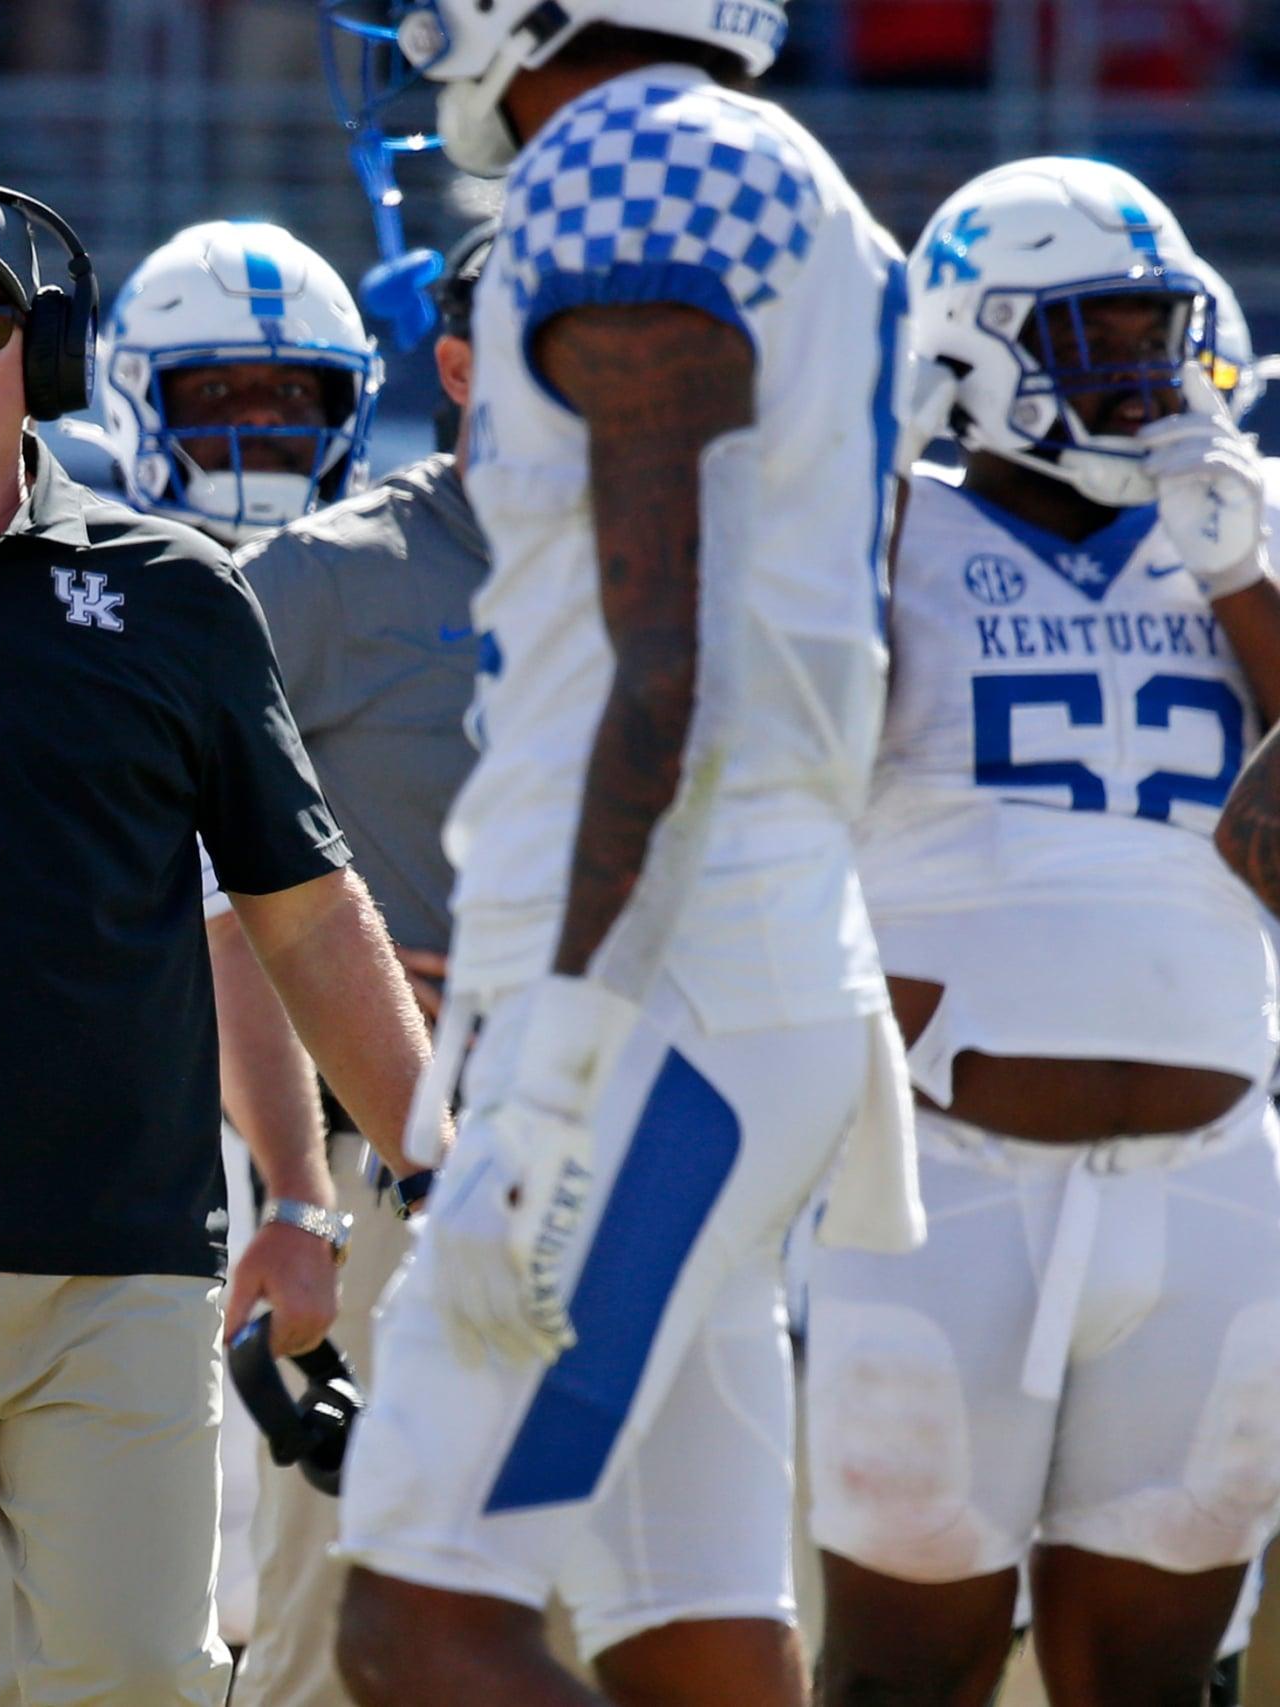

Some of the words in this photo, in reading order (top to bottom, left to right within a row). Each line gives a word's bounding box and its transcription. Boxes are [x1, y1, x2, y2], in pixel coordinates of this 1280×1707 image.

[50, 566, 125, 632] UK
[976, 613, 1221, 659] KENTUCKY
[971, 673, 1244, 823] 52
